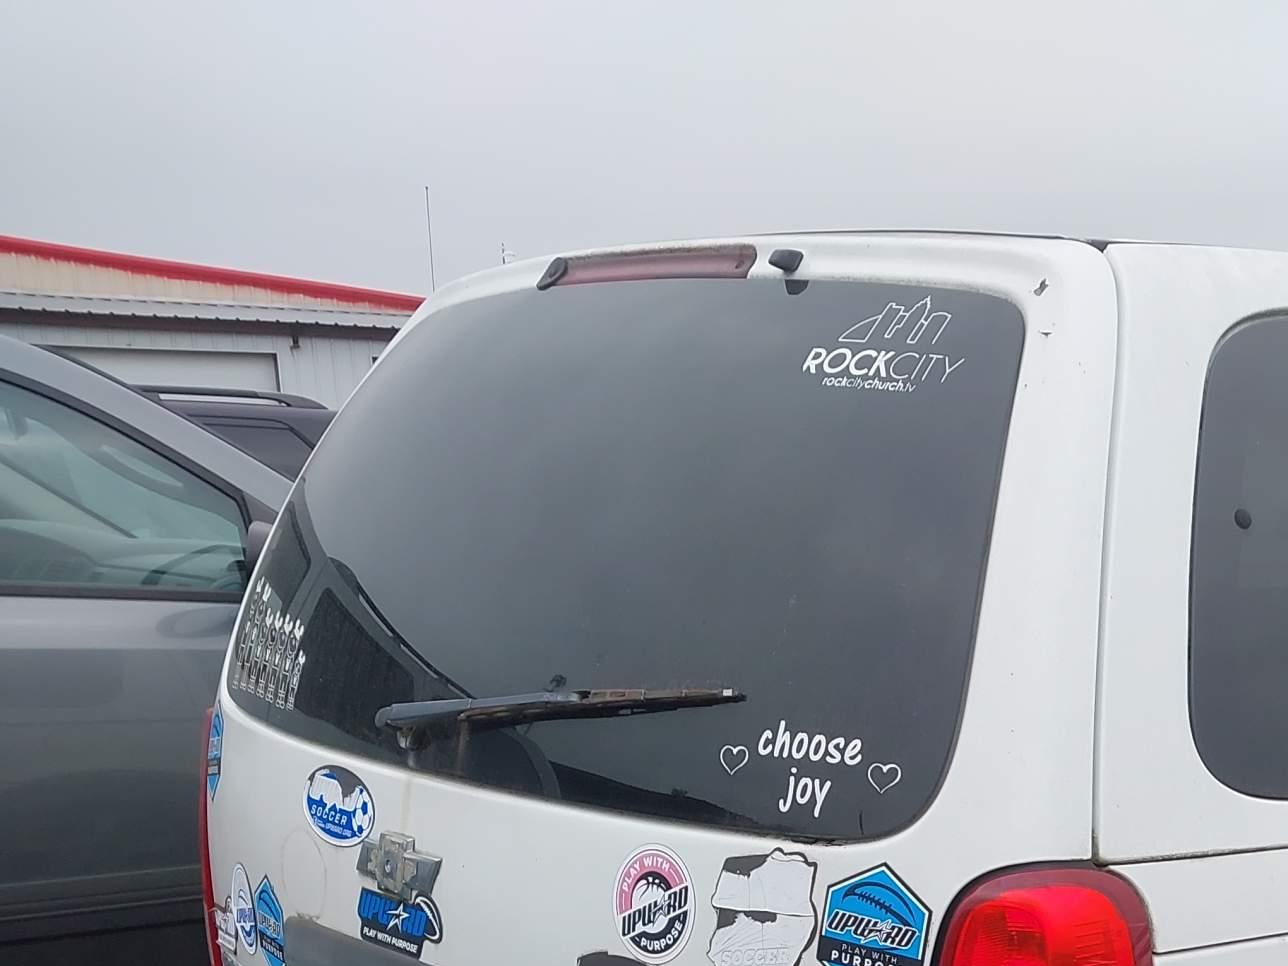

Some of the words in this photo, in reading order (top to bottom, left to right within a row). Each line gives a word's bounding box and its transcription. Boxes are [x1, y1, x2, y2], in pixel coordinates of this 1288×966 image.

[758, 720, 862, 766] choose
[778, 767, 832, 818] joy
[311, 804, 347, 826] SOCCER
[622, 861, 641, 891] PLAY
[643, 856, 670, 871] WITH
[363, 926, 376, 938] PLAY
[377, 931, 391, 944] WITH
[391, 936, 418, 953] PURPOSE
[640, 920, 682, 951] PURPOSE
[842, 944, 867, 956] PLAY
[872, 951, 897, 964] WITH
